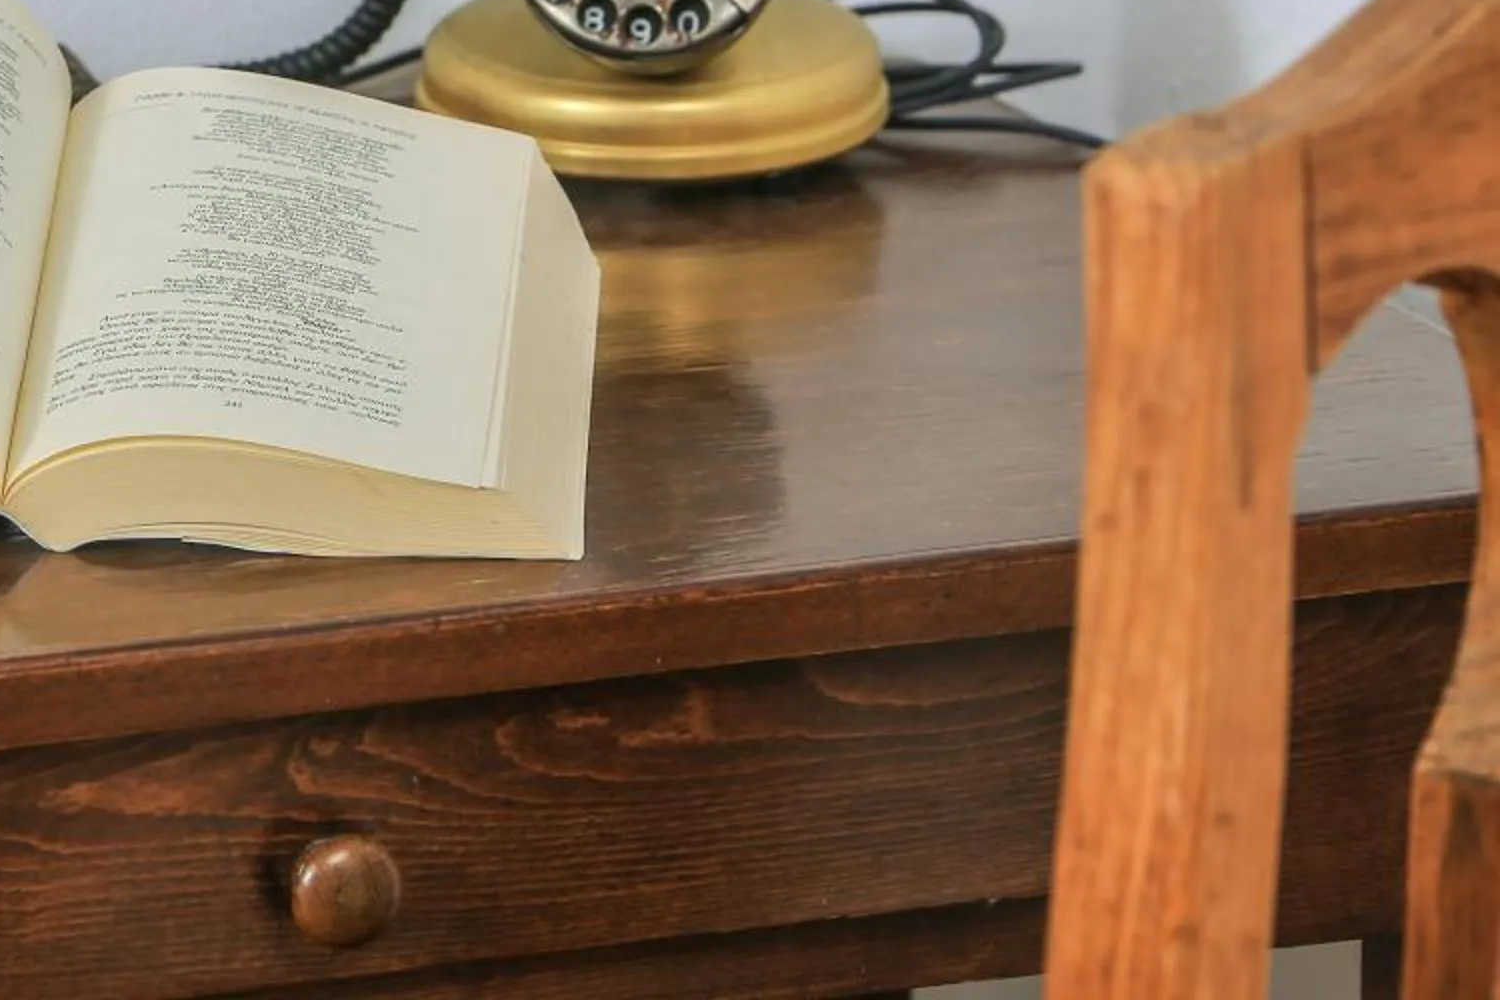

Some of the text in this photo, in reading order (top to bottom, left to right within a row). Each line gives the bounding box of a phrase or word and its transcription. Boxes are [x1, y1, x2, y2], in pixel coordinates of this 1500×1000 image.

[583, 7, 605, 32] 8
[630, 19, 652, 45] 9
[677, 10, 700, 35] 0
